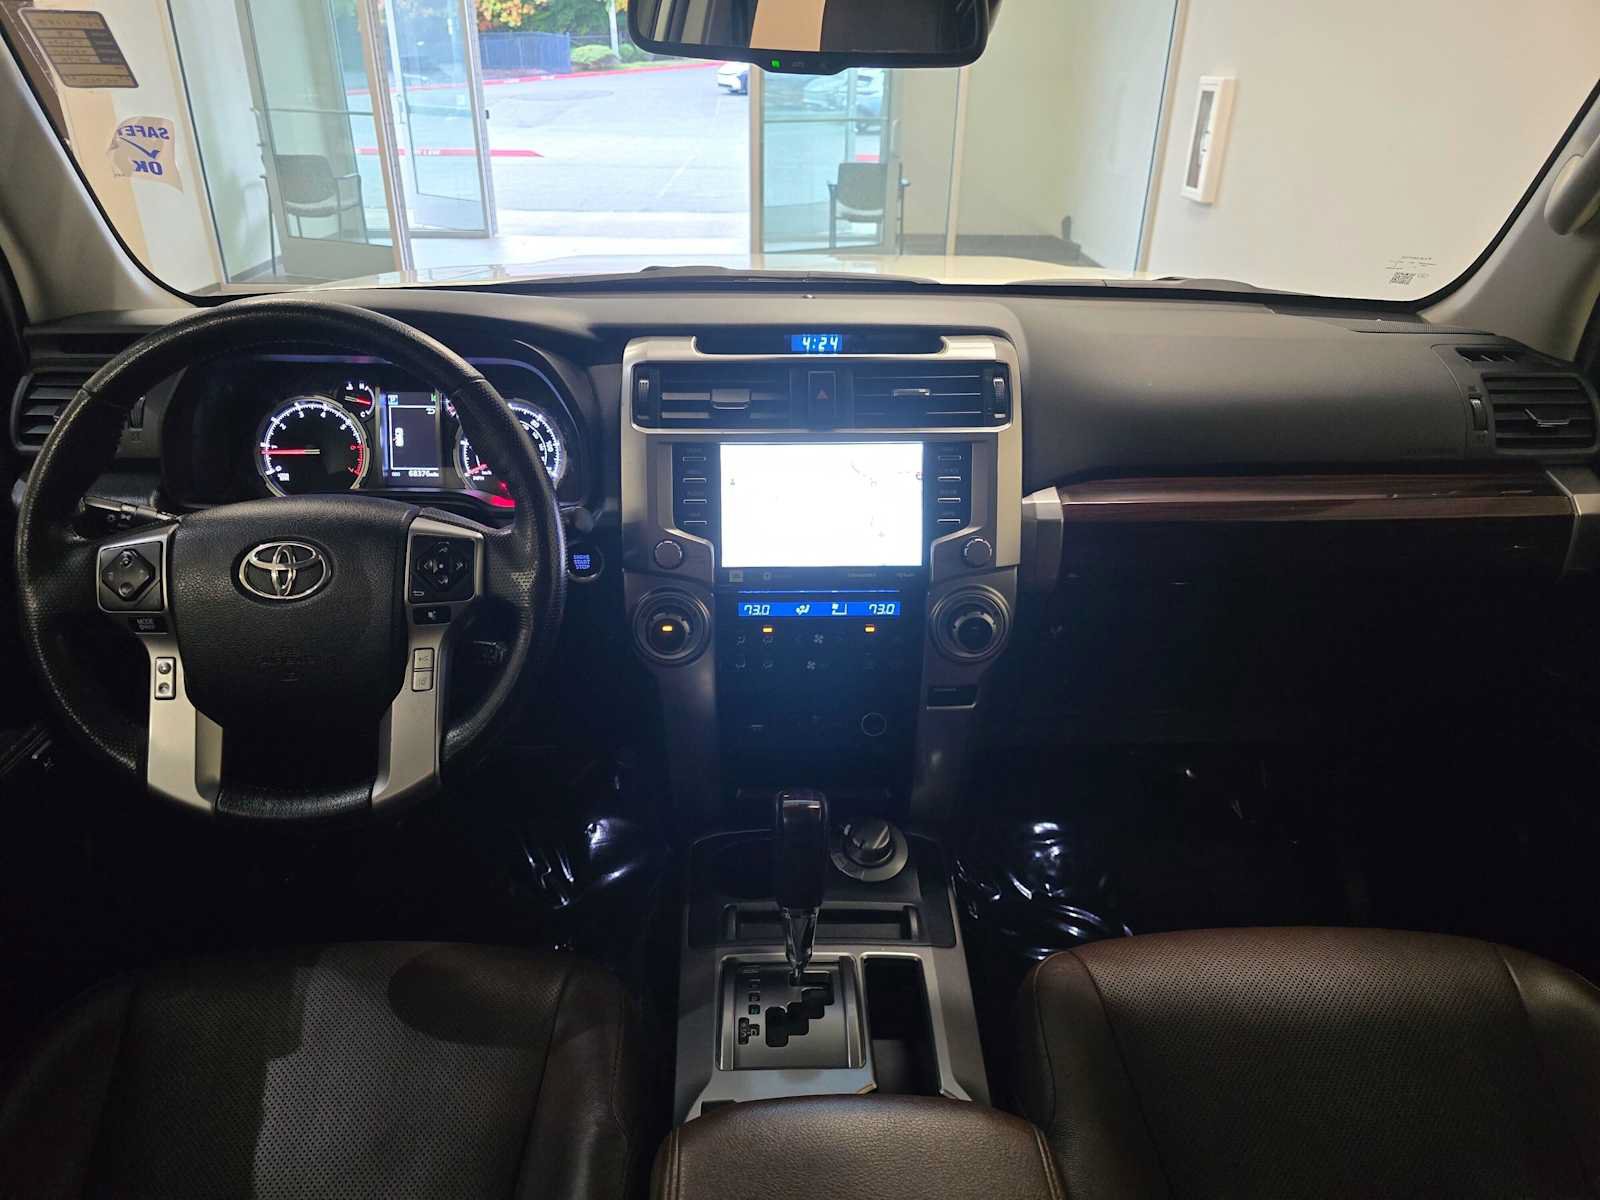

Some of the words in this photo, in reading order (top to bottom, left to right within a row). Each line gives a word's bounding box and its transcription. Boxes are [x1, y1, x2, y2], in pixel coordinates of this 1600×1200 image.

[802, 336, 838, 352] 4:24
[743, 604, 770, 616] 73.0
[868, 603, 895, 615] 73.0
